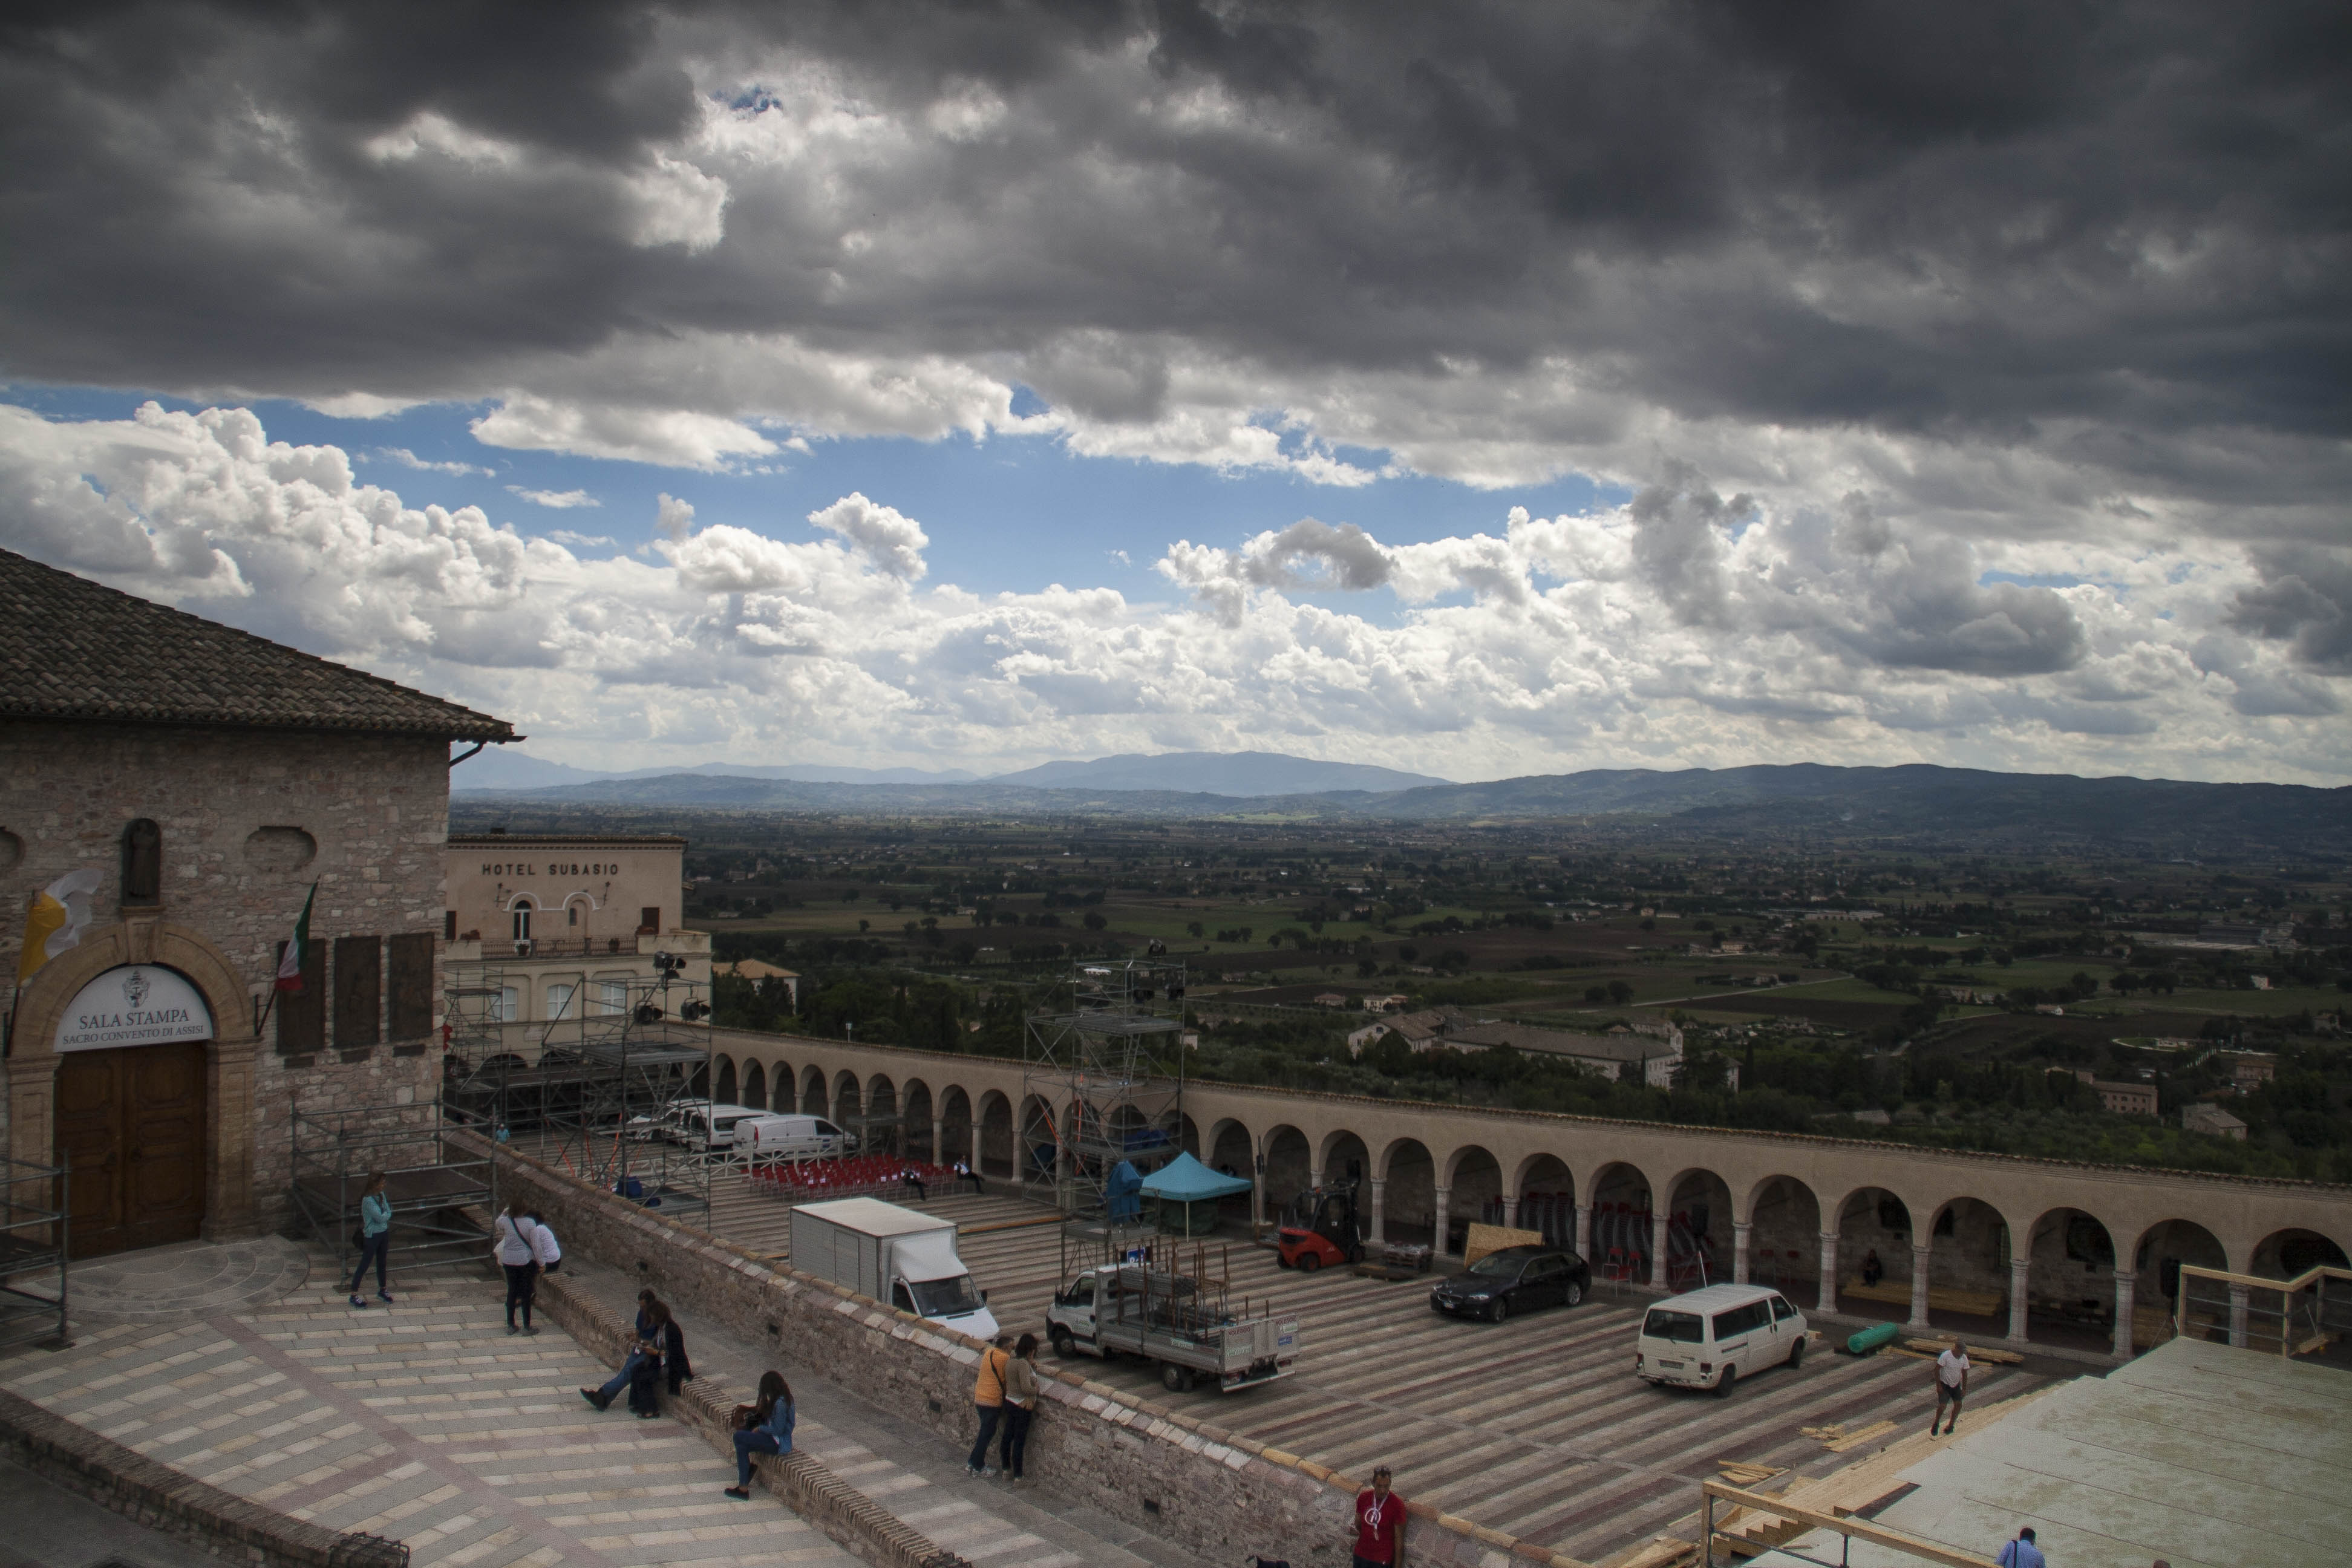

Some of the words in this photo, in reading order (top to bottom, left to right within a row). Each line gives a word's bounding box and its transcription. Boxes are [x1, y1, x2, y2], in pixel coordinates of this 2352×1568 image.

[482, 864, 536, 875] HOTEL
[549, 864, 618, 875] SUBASIO
[79, 1013, 122, 1030] SALA
[126, 1009, 189, 1026] STAMPA
[62, 1034, 99, 1045] SACRO
[100, 1028, 160, 1042] CONVENTO
[162, 1027, 173, 1037] DI
[175, 1025, 204, 1036] ASSISI
